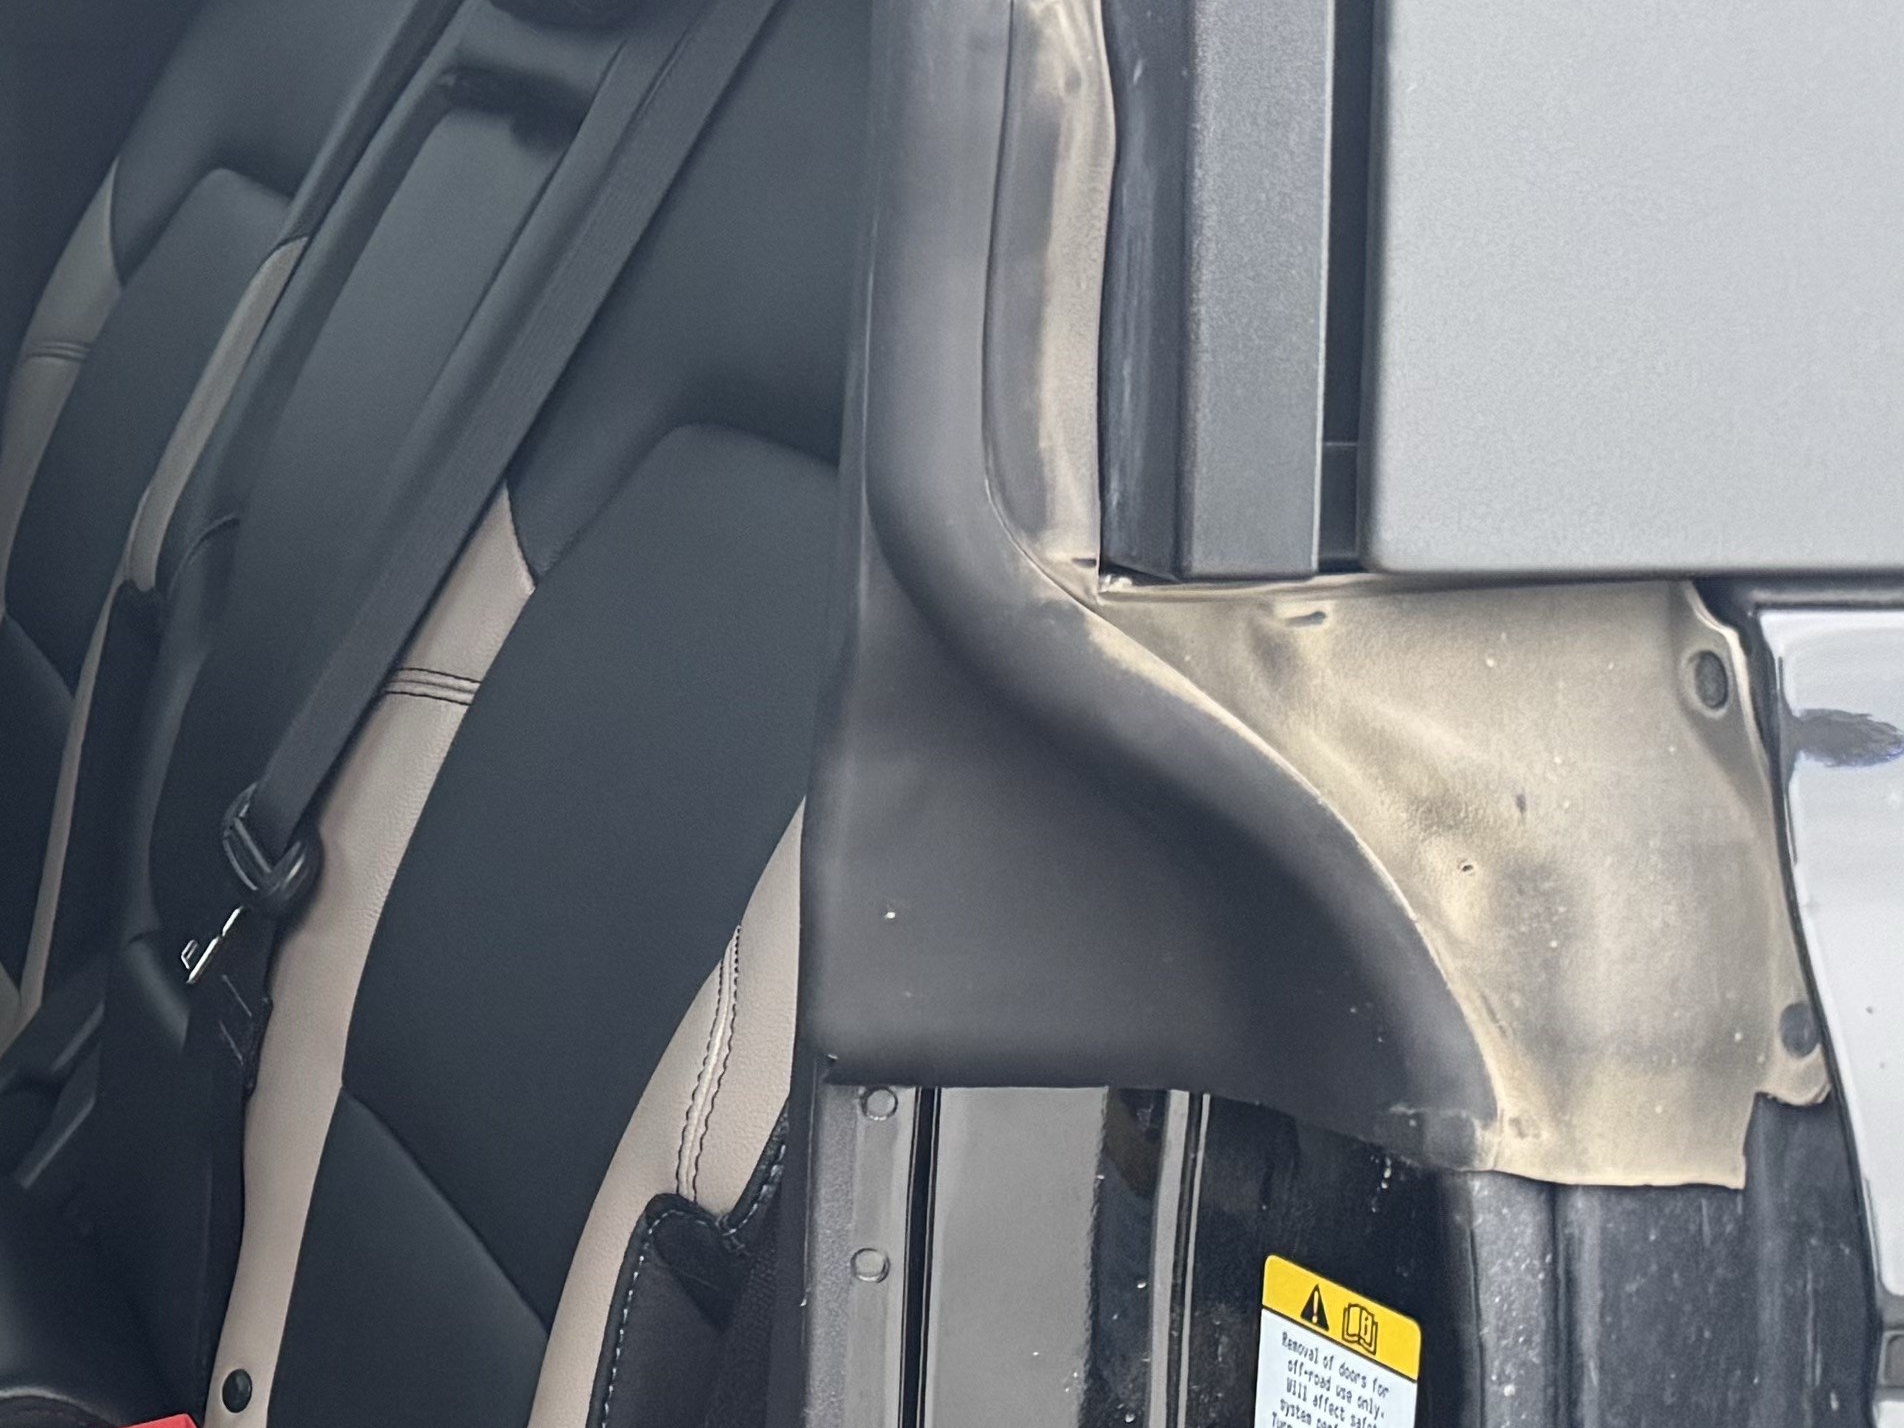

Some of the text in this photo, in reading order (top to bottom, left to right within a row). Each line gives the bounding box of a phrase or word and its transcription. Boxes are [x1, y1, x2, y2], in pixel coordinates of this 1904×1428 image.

[1282, 1331, 1390, 1399] Removal of doors for
[1288, 1360, 1385, 1418] off-road use only.
[1280, 1399, 1312, 1425] system
[1286, 1377, 1307, 1401] Will
[1313, 1395, 1345, 1422] affect
